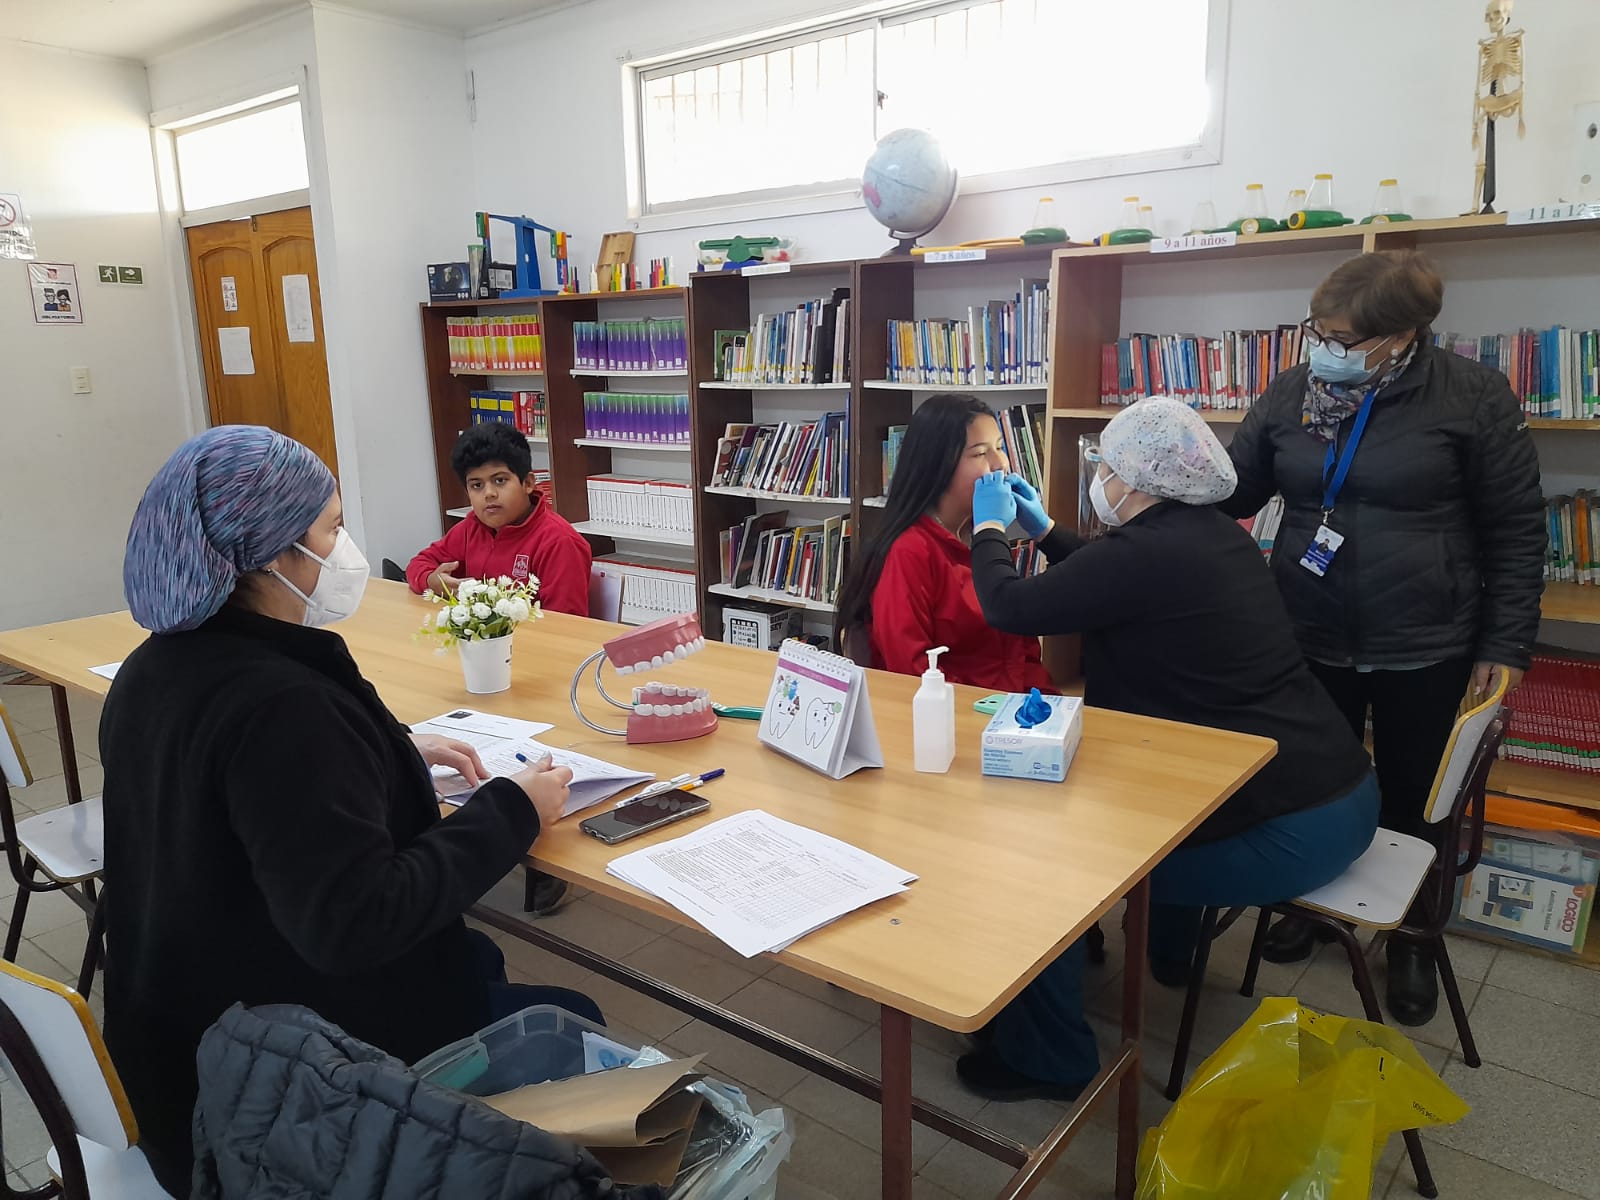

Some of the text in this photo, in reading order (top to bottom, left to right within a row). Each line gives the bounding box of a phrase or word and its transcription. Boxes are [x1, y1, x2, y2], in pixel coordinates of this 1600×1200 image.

[1528, 202, 1587, 220] 11 a 12
[1164, 234, 1227, 248] 9 a 11 años
